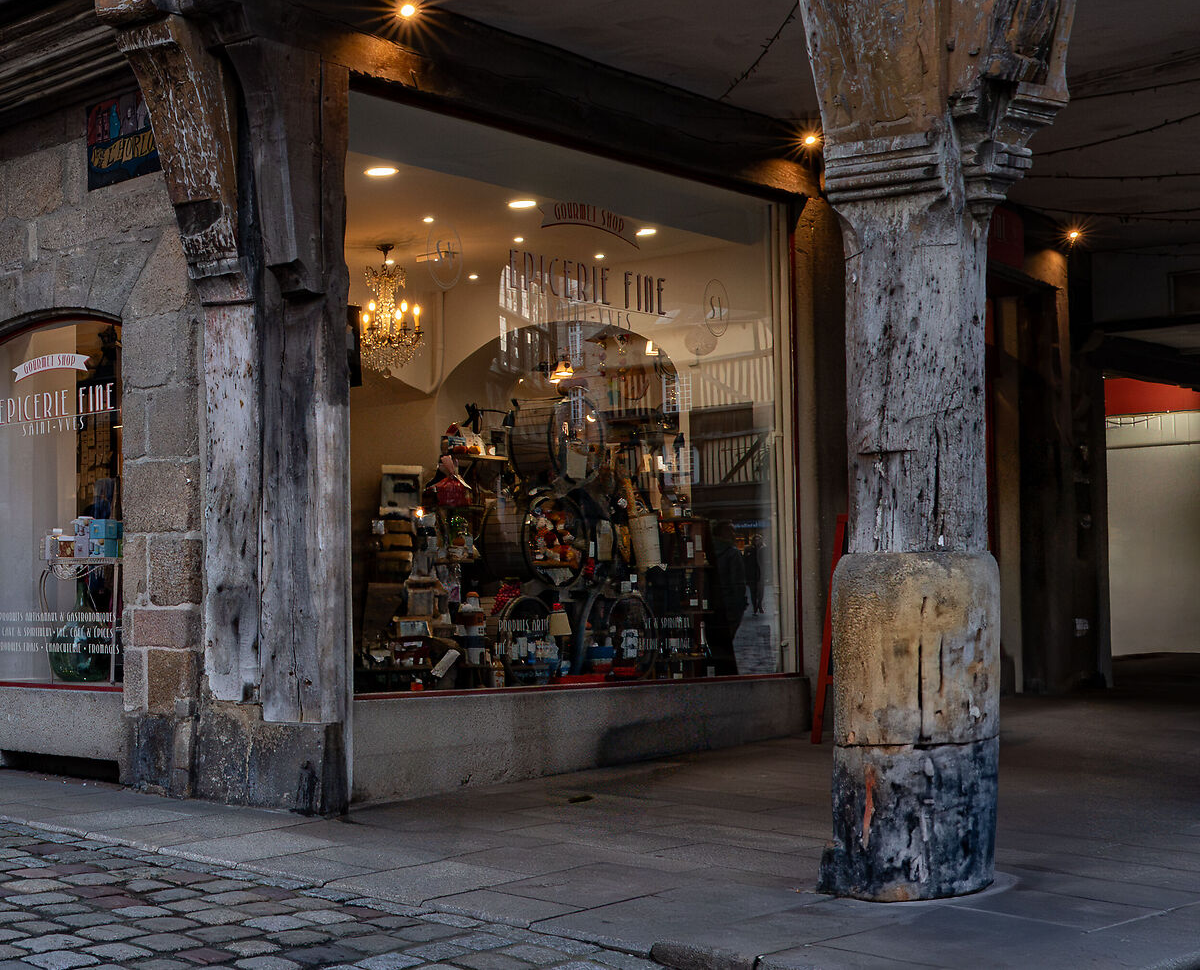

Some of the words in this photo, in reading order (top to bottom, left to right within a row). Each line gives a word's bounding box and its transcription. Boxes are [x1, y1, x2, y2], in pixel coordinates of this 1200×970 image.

[554, 202, 596, 223] GOURMET
[602, 210, 625, 233] SHOP
[509, 249, 611, 305] EPICERIE
[624, 270, 667, 315] FINE
[23, 355, 55, 374] GOURMET
[57, 355, 76, 366] SHOP
[78, 382, 115, 414] FINE
[67, 611, 117, 623] GASTRONOMIQUES
[89, 643, 120, 655] FROMAGES
